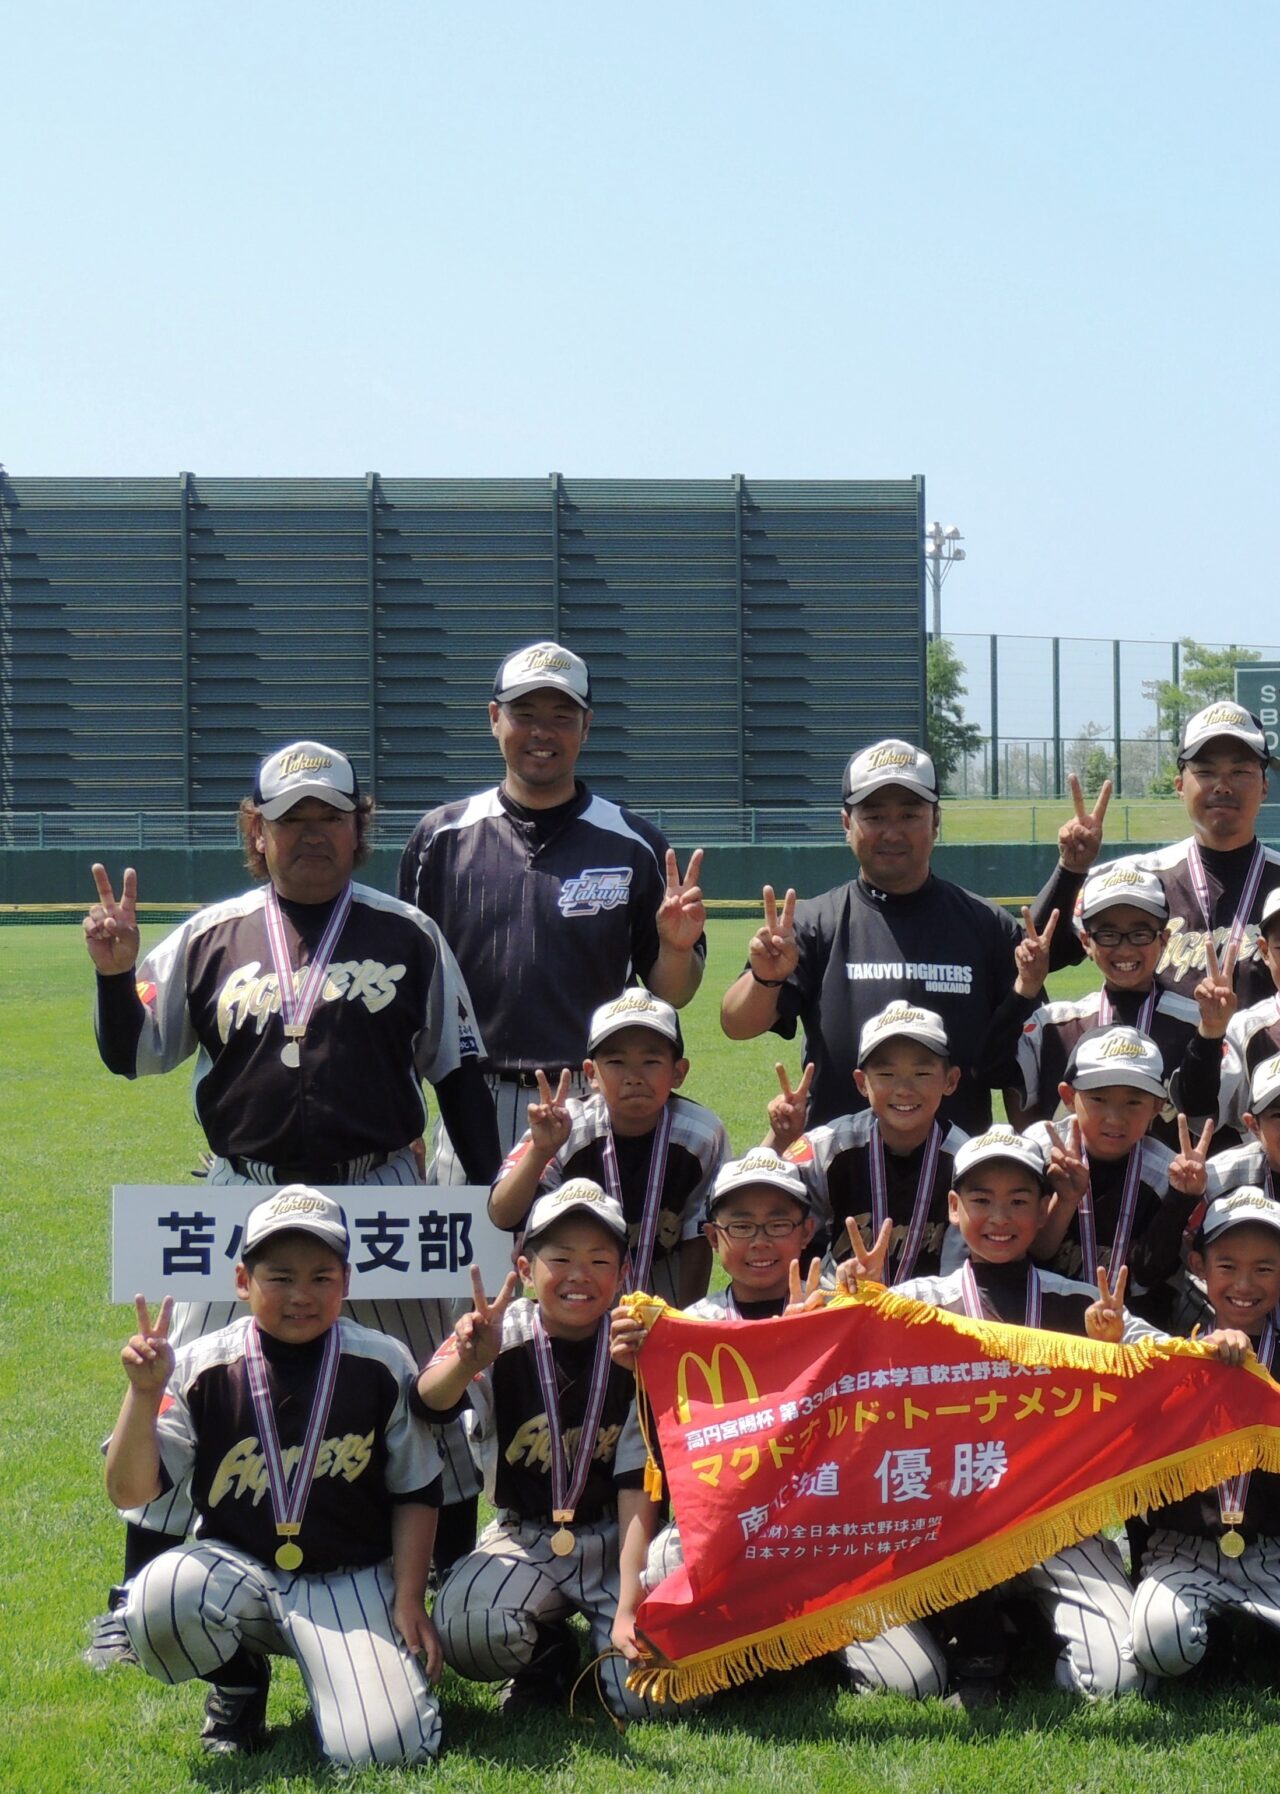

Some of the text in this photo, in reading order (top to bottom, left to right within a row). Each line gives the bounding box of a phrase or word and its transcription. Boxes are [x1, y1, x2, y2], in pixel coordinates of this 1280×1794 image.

[1261, 685, 1276, 703] S
[1260, 708, 1278, 725] B
[846, 962, 973, 983] TAKUYU FIGHTERS
[925, 981, 971, 994] HOKKAIDO
[157, 1210, 474, 1275] 苫支部
[685, 1408, 775, 1450] 高円宮賜杯
[873, 1440, 1008, 1504] 優勝
